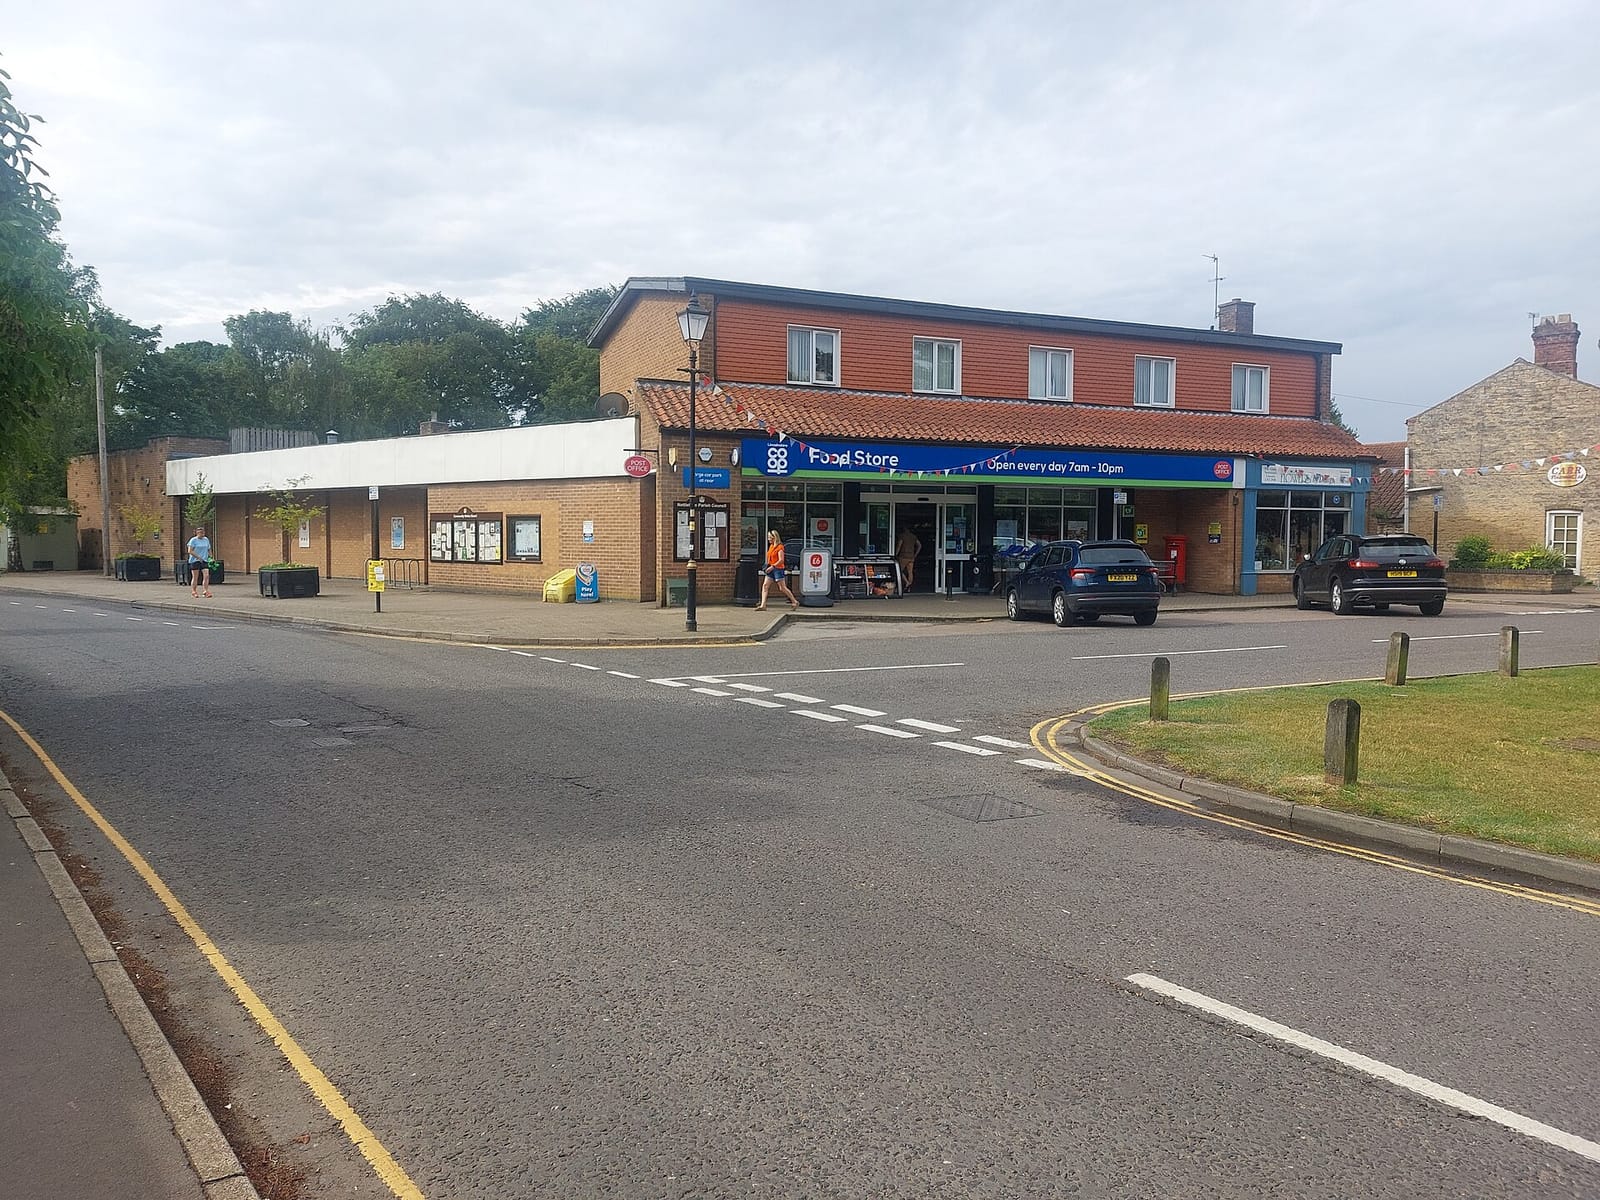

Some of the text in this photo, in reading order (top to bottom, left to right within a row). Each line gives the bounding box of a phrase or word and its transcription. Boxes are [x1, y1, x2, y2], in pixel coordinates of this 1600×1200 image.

[810, 449, 899, 466] Food Store
[988, 460, 1016, 472] Open
[1017, 462, 1046, 473] every
[1048, 461, 1067, 474] day
[1069, 462, 1090, 472] 7am
[1098, 463, 1124, 475] 10pm
